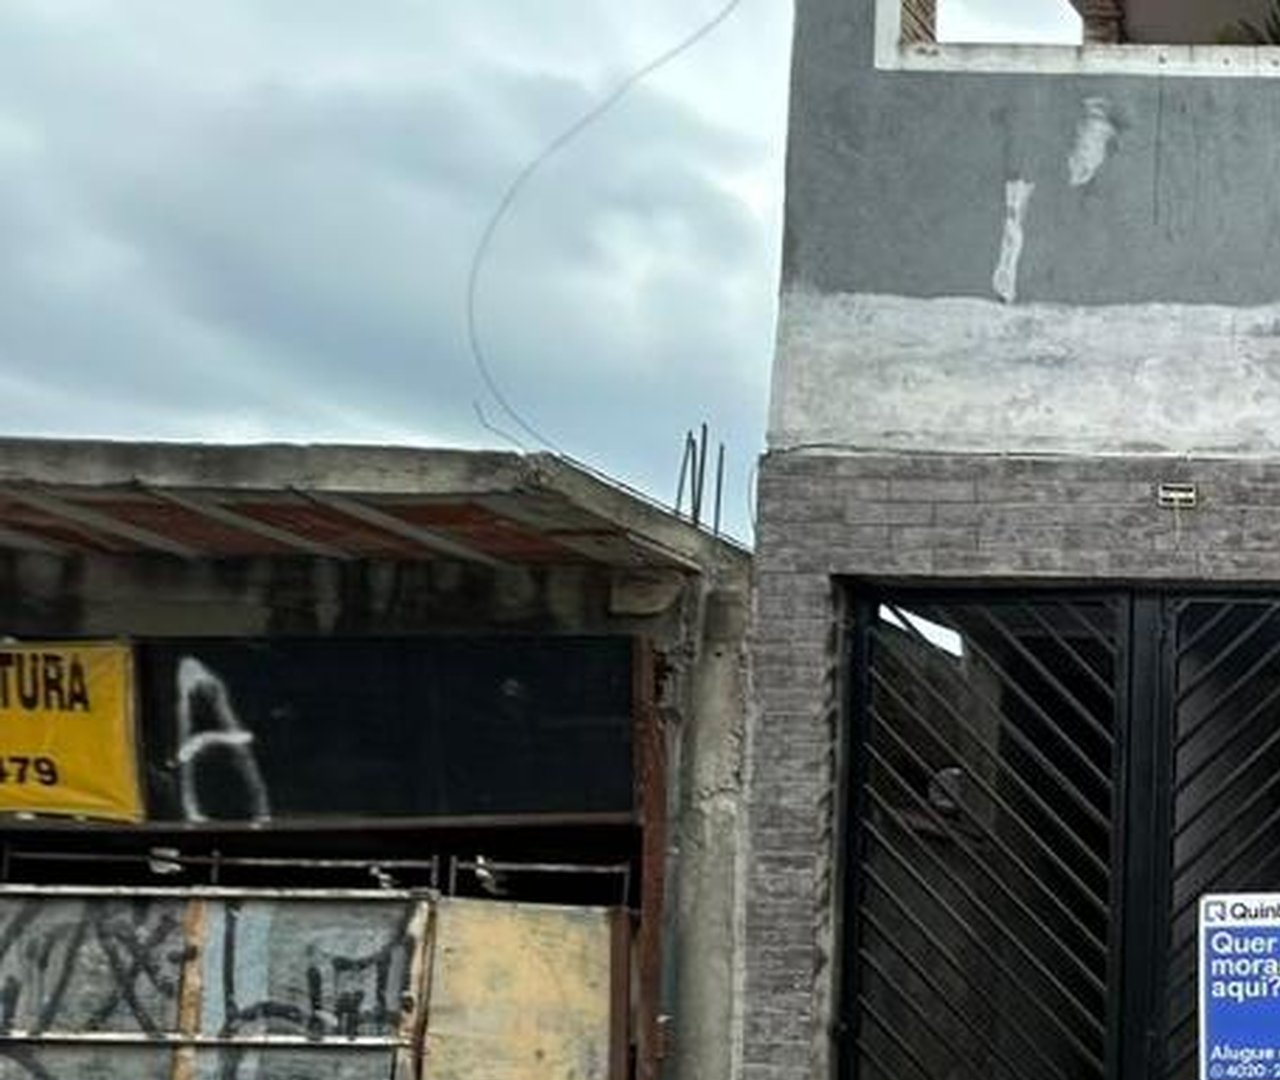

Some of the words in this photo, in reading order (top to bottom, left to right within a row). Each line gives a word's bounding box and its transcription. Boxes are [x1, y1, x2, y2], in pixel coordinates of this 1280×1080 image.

[0, 652, 90, 713] TURA
[1211, 931, 1278, 955] Quer
[1210, 1044, 1274, 1063] Alugue
